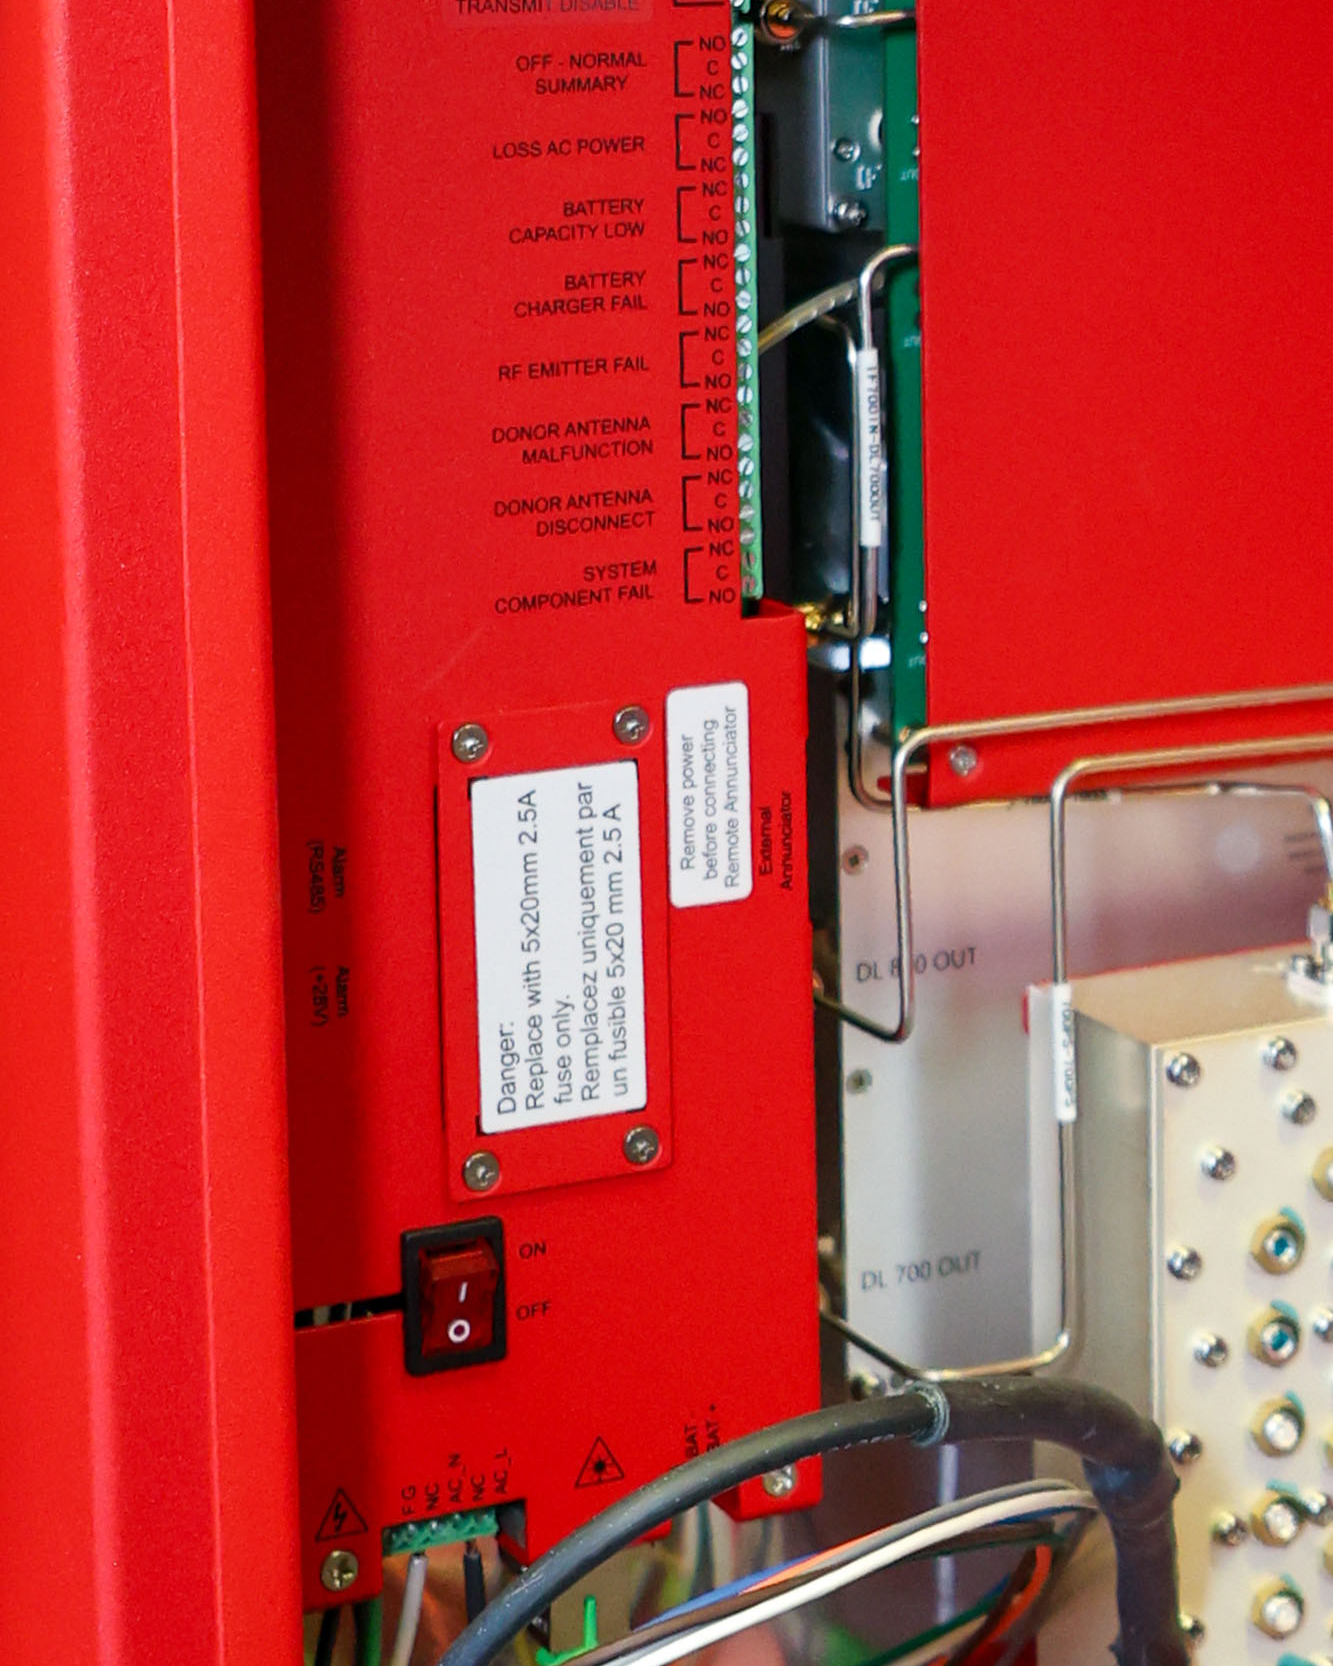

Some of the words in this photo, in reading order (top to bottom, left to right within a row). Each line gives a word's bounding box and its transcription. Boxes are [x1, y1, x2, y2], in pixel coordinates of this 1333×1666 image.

[700, 35, 726, 52] NO
[515, 54, 552, 71] OFF
[569, 51, 647, 69] NORMAL
[706, 60, 719, 77] C
[535, 75, 629, 95] SUMMARY
[700, 84, 725, 101] NC
[700, 108, 728, 125] NO
[493, 141, 542, 160] LOSS
[546, 140, 572, 156] AC
[577, 136, 646, 155] POWER
[707, 133, 720, 150] C
[700, 157, 727, 174] NC
[702, 180, 728, 197] NC
[563, 198, 645, 217] BATTERY
[708, 205, 722, 222] C
[508, 223, 599, 244] CAPACITY
[604, 221, 645, 238] LOW
[702, 229, 729, 246] NO
[703, 253, 729, 270] NC
[564, 270, 647, 290] BATTERY
[710, 277, 724, 293] C
[513, 296, 605, 319] CHARGER
[611, 294, 649, 312] FAIL
[703, 301, 730, 318] NO
[704, 325, 730, 341] NC
[498, 365, 522, 381] RF
[528, 359, 608, 379] EMITTER
[613, 355, 650, 372] FAIL
[711, 349, 725, 366] C
[704, 373, 732, 390] NO
[705, 397, 732, 414] NC
[491, 423, 561, 444] DONOR
[565, 416, 651, 437] ANTENNA
[712, 421, 726, 438] C
[521, 439, 655, 465] MALFUNCTION
[706, 444, 733, 461] NO
[707, 468, 734, 486] NC
[493, 496, 562, 517] DONOR
[565, 488, 655, 509] ANTENNA
[714, 493, 728, 510] C
[536, 511, 657, 538] DISCONNECT
[707, 516, 735, 533] NO
[708, 540, 735, 557] NC
[583, 560, 658, 582] SYSTEM
[715, 565, 729, 581] C
[494, 587, 613, 615] COMPONENT
[617, 584, 656, 602] FAIL
[708, 587, 737, 604] NO
[681, 734, 698, 790] power
[701, 718, 720, 818] connecting
[722, 705, 739, 813] Annunciator
[577, 781, 598, 820] par
[602, 802, 622, 822] A
[517, 789, 538, 846] 2.5A
[680, 794, 696, 871] Remove
[758, 805, 773, 876] External
[780, 789, 794, 892] Annunciator
[602, 827, 623, 865] 2.5
[703, 823, 718, 881] before
[724, 817, 740, 889] Remote
[519, 852, 541, 954] 5x20mm
[576, 825, 601, 965] uniquement
[608, 871, 624, 915] mm
[605, 922, 626, 979] 5x20
[856, 961, 883, 983] DL
[932, 946, 978, 973] OUT
[521, 960, 542, 1008] with
[552, 994, 576, 1048] only.
[607, 985, 628, 1061] fusible
[580, 970, 603, 1102] Remplacez
[497, 1020, 521, 1115] Danger:
[524, 1014, 549, 1111] Replace
[553, 1054, 573, 1105] fuse
[613, 1067, 629, 1097] un
[519, 1240, 547, 1260] ON
[861, 1270, 888, 1292] DL
[896, 1260, 932, 1283] 700
[938, 1250, 982, 1277] OUT
[516, 1300, 552, 1321] OFF
[684, 1424, 700, 1459] BAT
[425, 1483, 440, 1511] NC
[472, 1474, 486, 1502] NC
